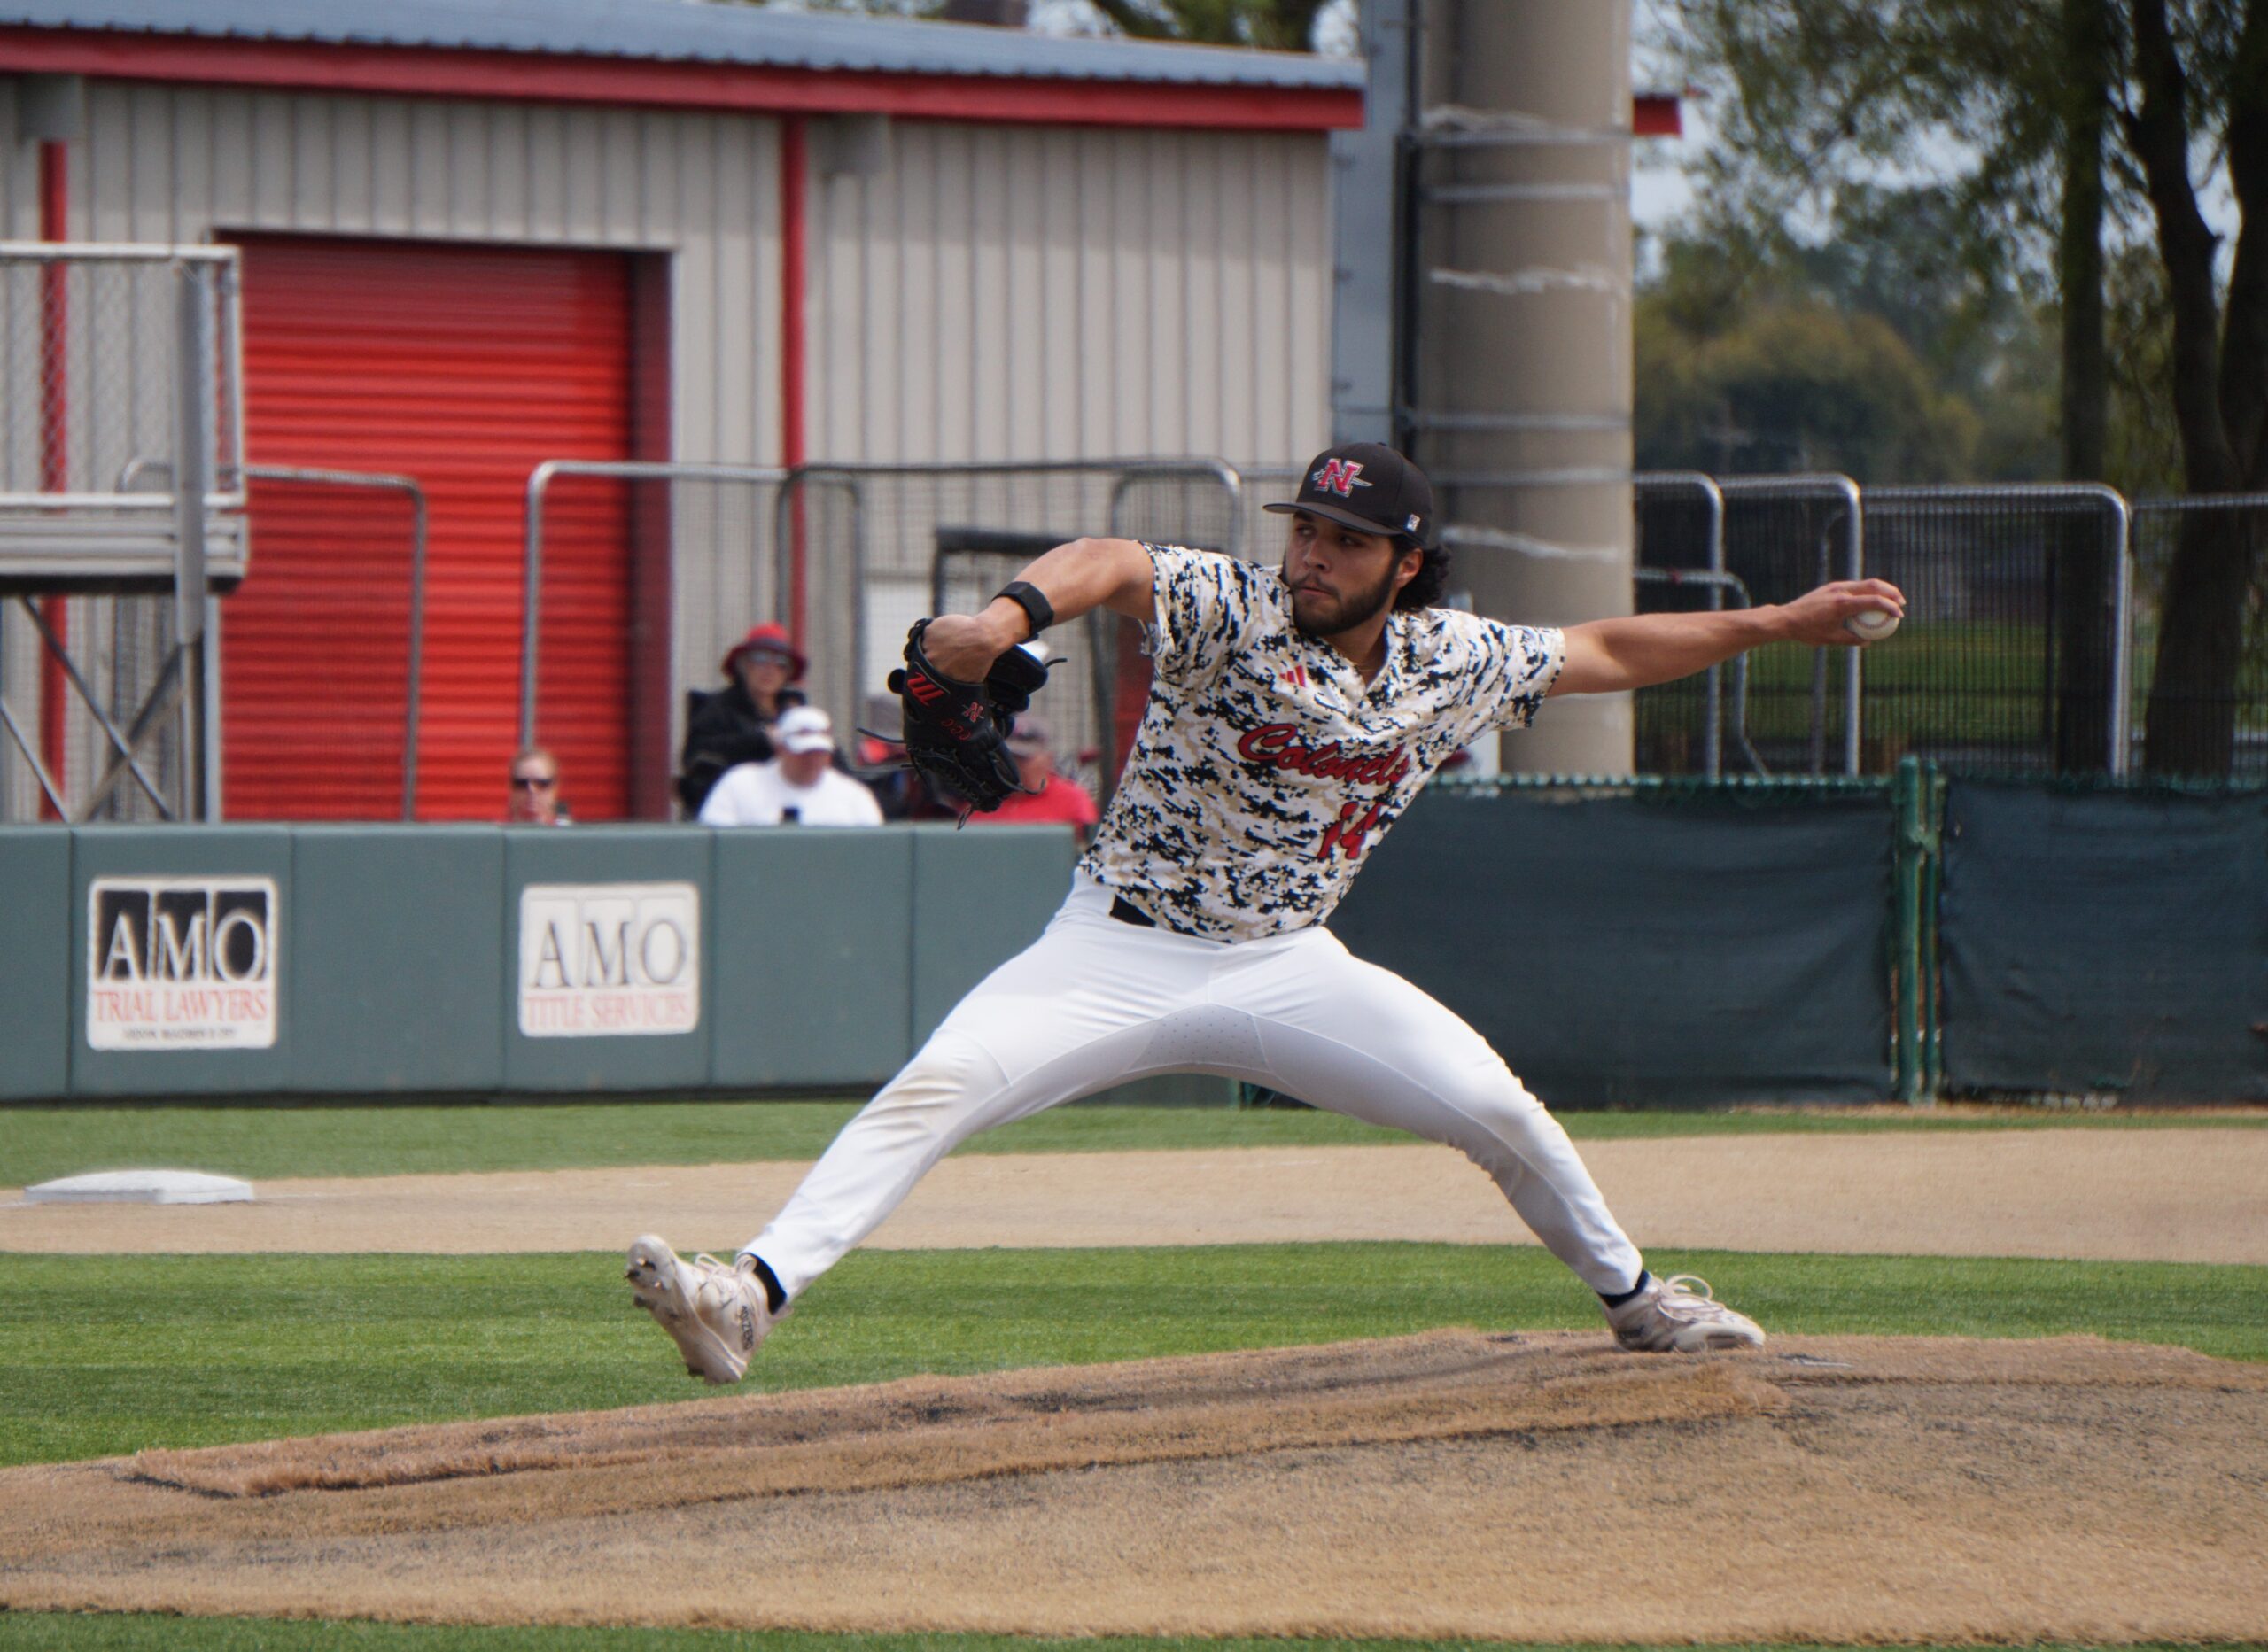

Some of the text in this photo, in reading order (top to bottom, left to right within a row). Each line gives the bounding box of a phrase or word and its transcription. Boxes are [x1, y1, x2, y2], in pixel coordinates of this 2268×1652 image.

[1315, 458, 1364, 498] N
[1239, 723, 1410, 785] Colonels
[1317, 800, 1386, 860] 14
[99, 912, 264, 983] AMO
[533, 919, 685, 988] AMO
[93, 989, 268, 1021] TRIAL LAWYERS
